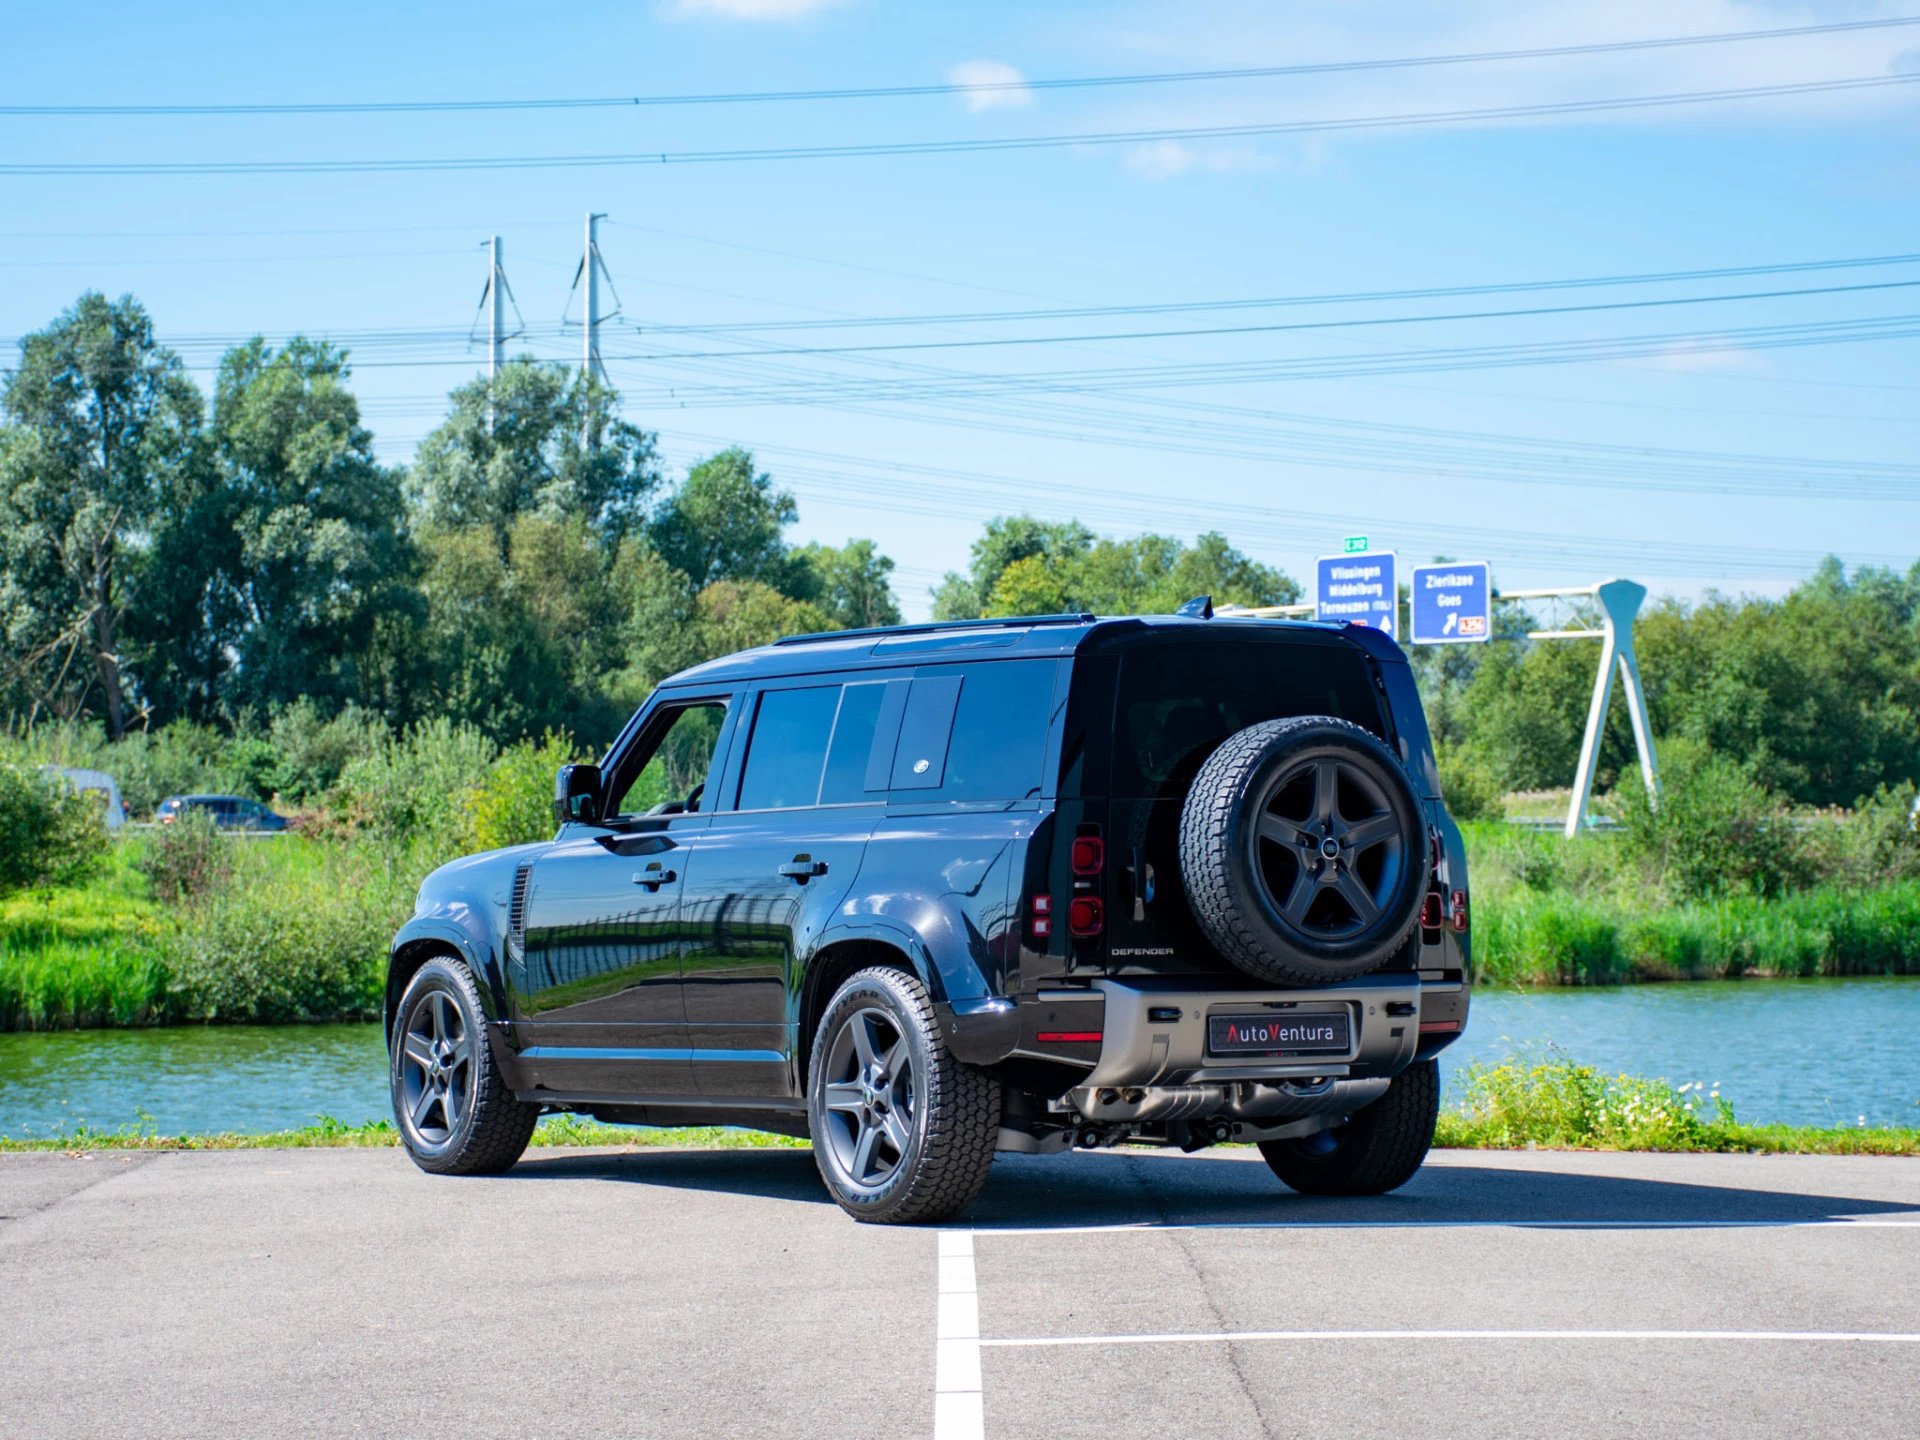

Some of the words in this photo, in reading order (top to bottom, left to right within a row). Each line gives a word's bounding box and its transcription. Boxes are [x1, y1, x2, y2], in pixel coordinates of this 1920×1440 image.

[1330, 566, 1381, 581] Vlissingen
[1425, 574, 1474, 589] Zierikzee
[1329, 583, 1382, 597] Middelburg
[1437, 593, 1462, 607] Goes
[1320, 601, 1369, 615] Terneuzen
[1111, 948, 1174, 956] DEFENDER
[1227, 1023, 1333, 1042] AutoVentura
